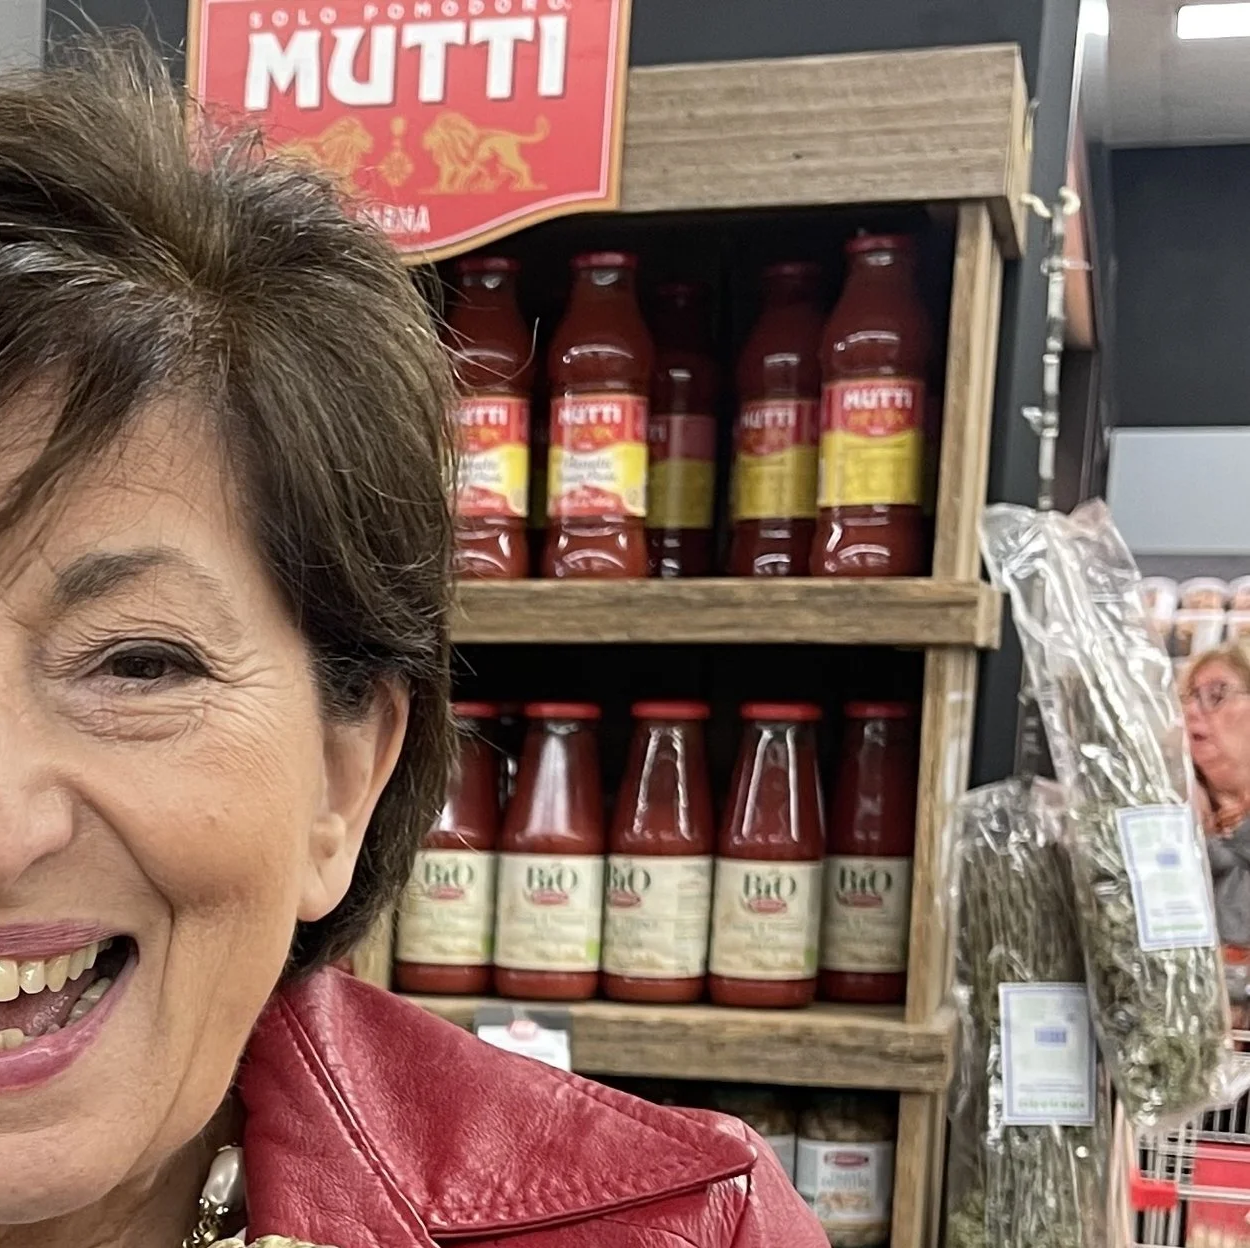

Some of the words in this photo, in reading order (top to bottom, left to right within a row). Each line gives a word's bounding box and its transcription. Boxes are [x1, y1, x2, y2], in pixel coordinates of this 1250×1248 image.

[249, 7, 338, 29] SOLO
[244, 15, 568, 110] MUTTI
[842, 388, 912, 410] MUTTI
[454, 405, 508, 426] UTTI
[558, 403, 622, 425] MUTTI
